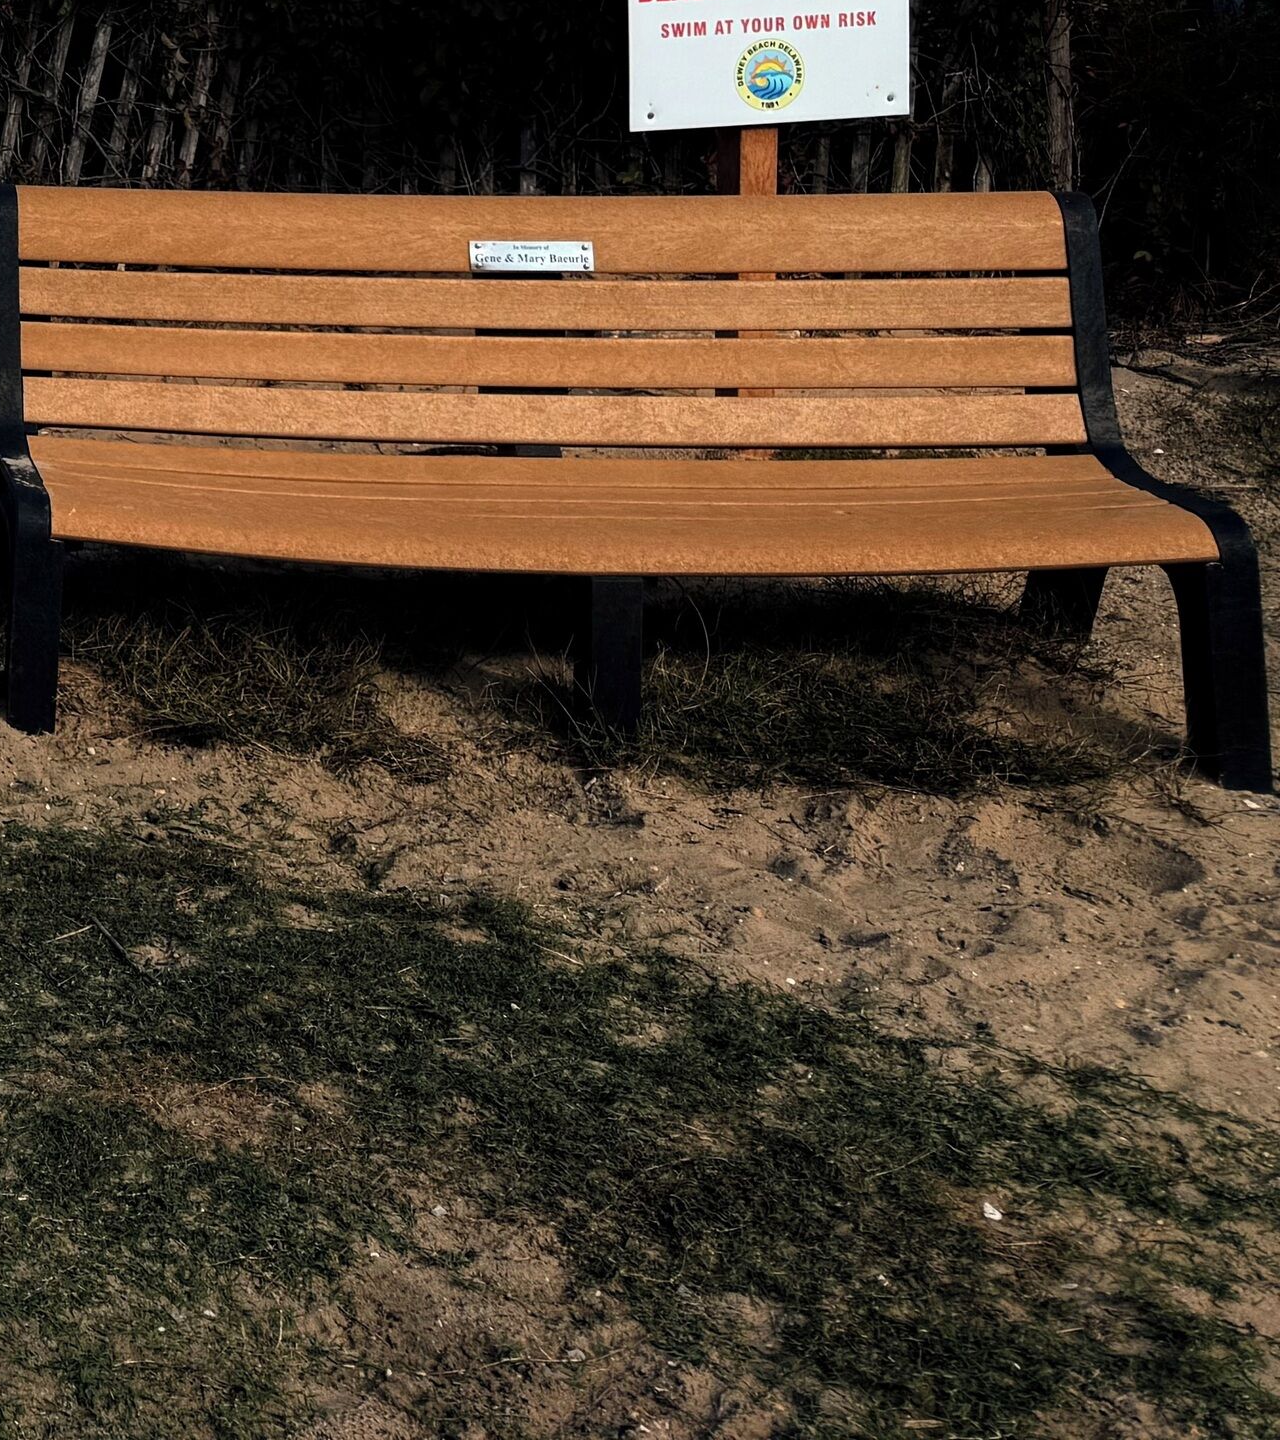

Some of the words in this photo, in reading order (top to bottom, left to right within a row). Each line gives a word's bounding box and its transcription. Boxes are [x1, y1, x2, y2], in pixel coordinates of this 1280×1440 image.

[661, 21, 707, 38] SWIM
[715, 19, 734, 35] AT
[740, 16, 785, 33] YOUR
[793, 13, 831, 30] OWN
[838, 11, 877, 28] RISK
[736, 55, 748, 87] DEWEY
[747, 41, 776, 56] BEACH
[778, 42, 802, 85] DELAWARE
[475, 253, 502, 263] Gene
[504, 253, 514, 263] &
[518, 253, 546, 265] Mary
